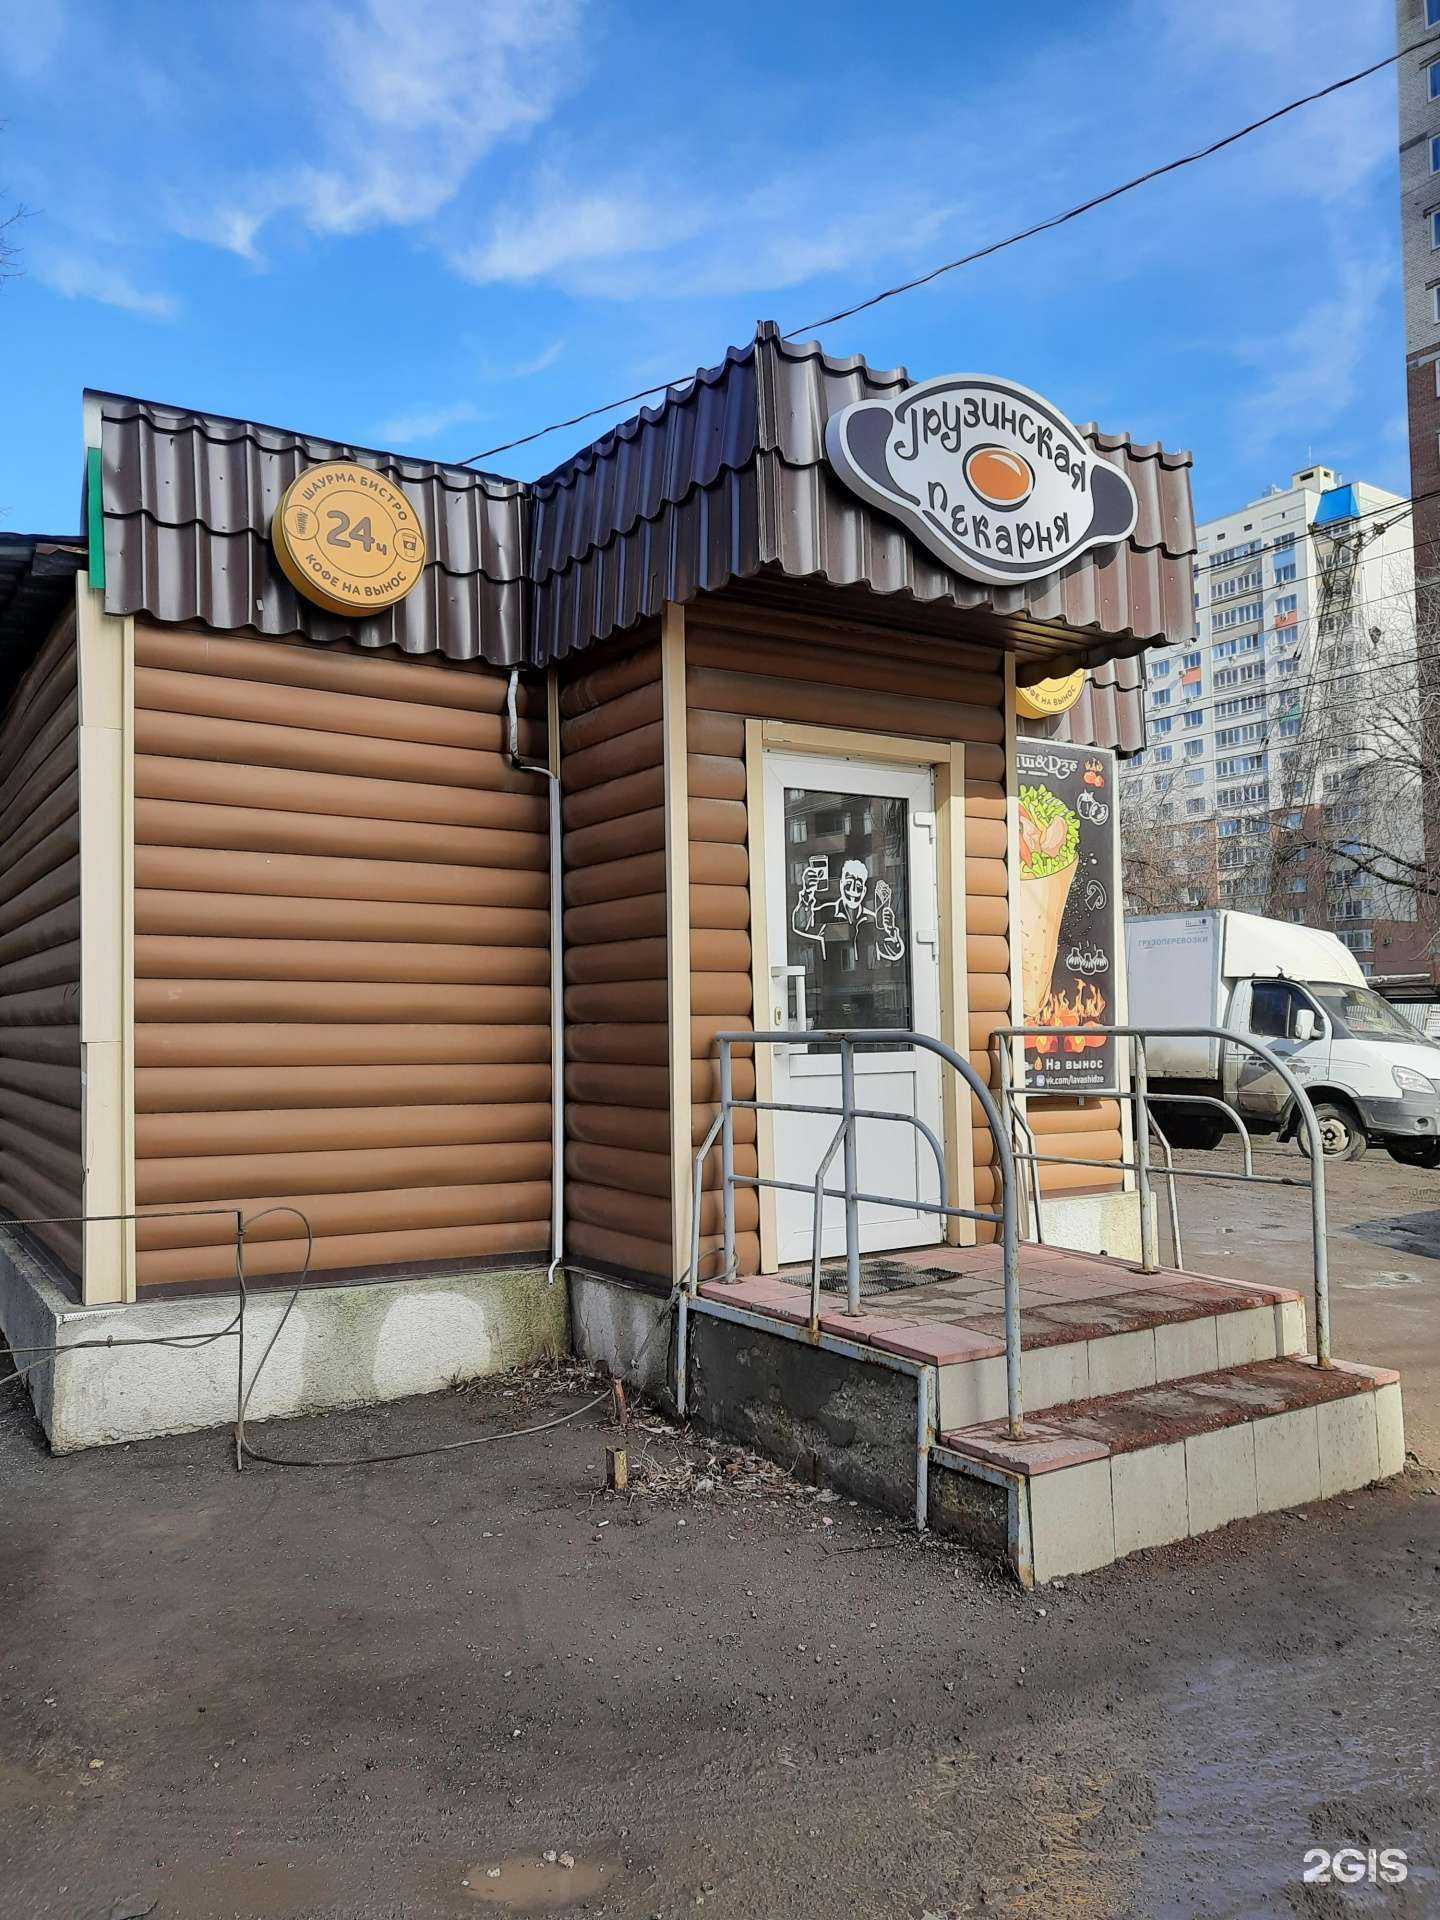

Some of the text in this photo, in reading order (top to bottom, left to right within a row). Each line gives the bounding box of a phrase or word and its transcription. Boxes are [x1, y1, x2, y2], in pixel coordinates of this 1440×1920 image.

[302, 472, 408, 521] ШАУРМА БИСТРО
[305, 553, 407, 597] КОФЕ НА ВЫНОС
[1041, 696, 1052, 705] НА
[1053, 685, 1076, 706] ВЫНОС
[1138, 936, 1209, 946] ГРУЗОПЕРЕВОЗКИ
[1045, 1059, 1104, 1071] На вынос
